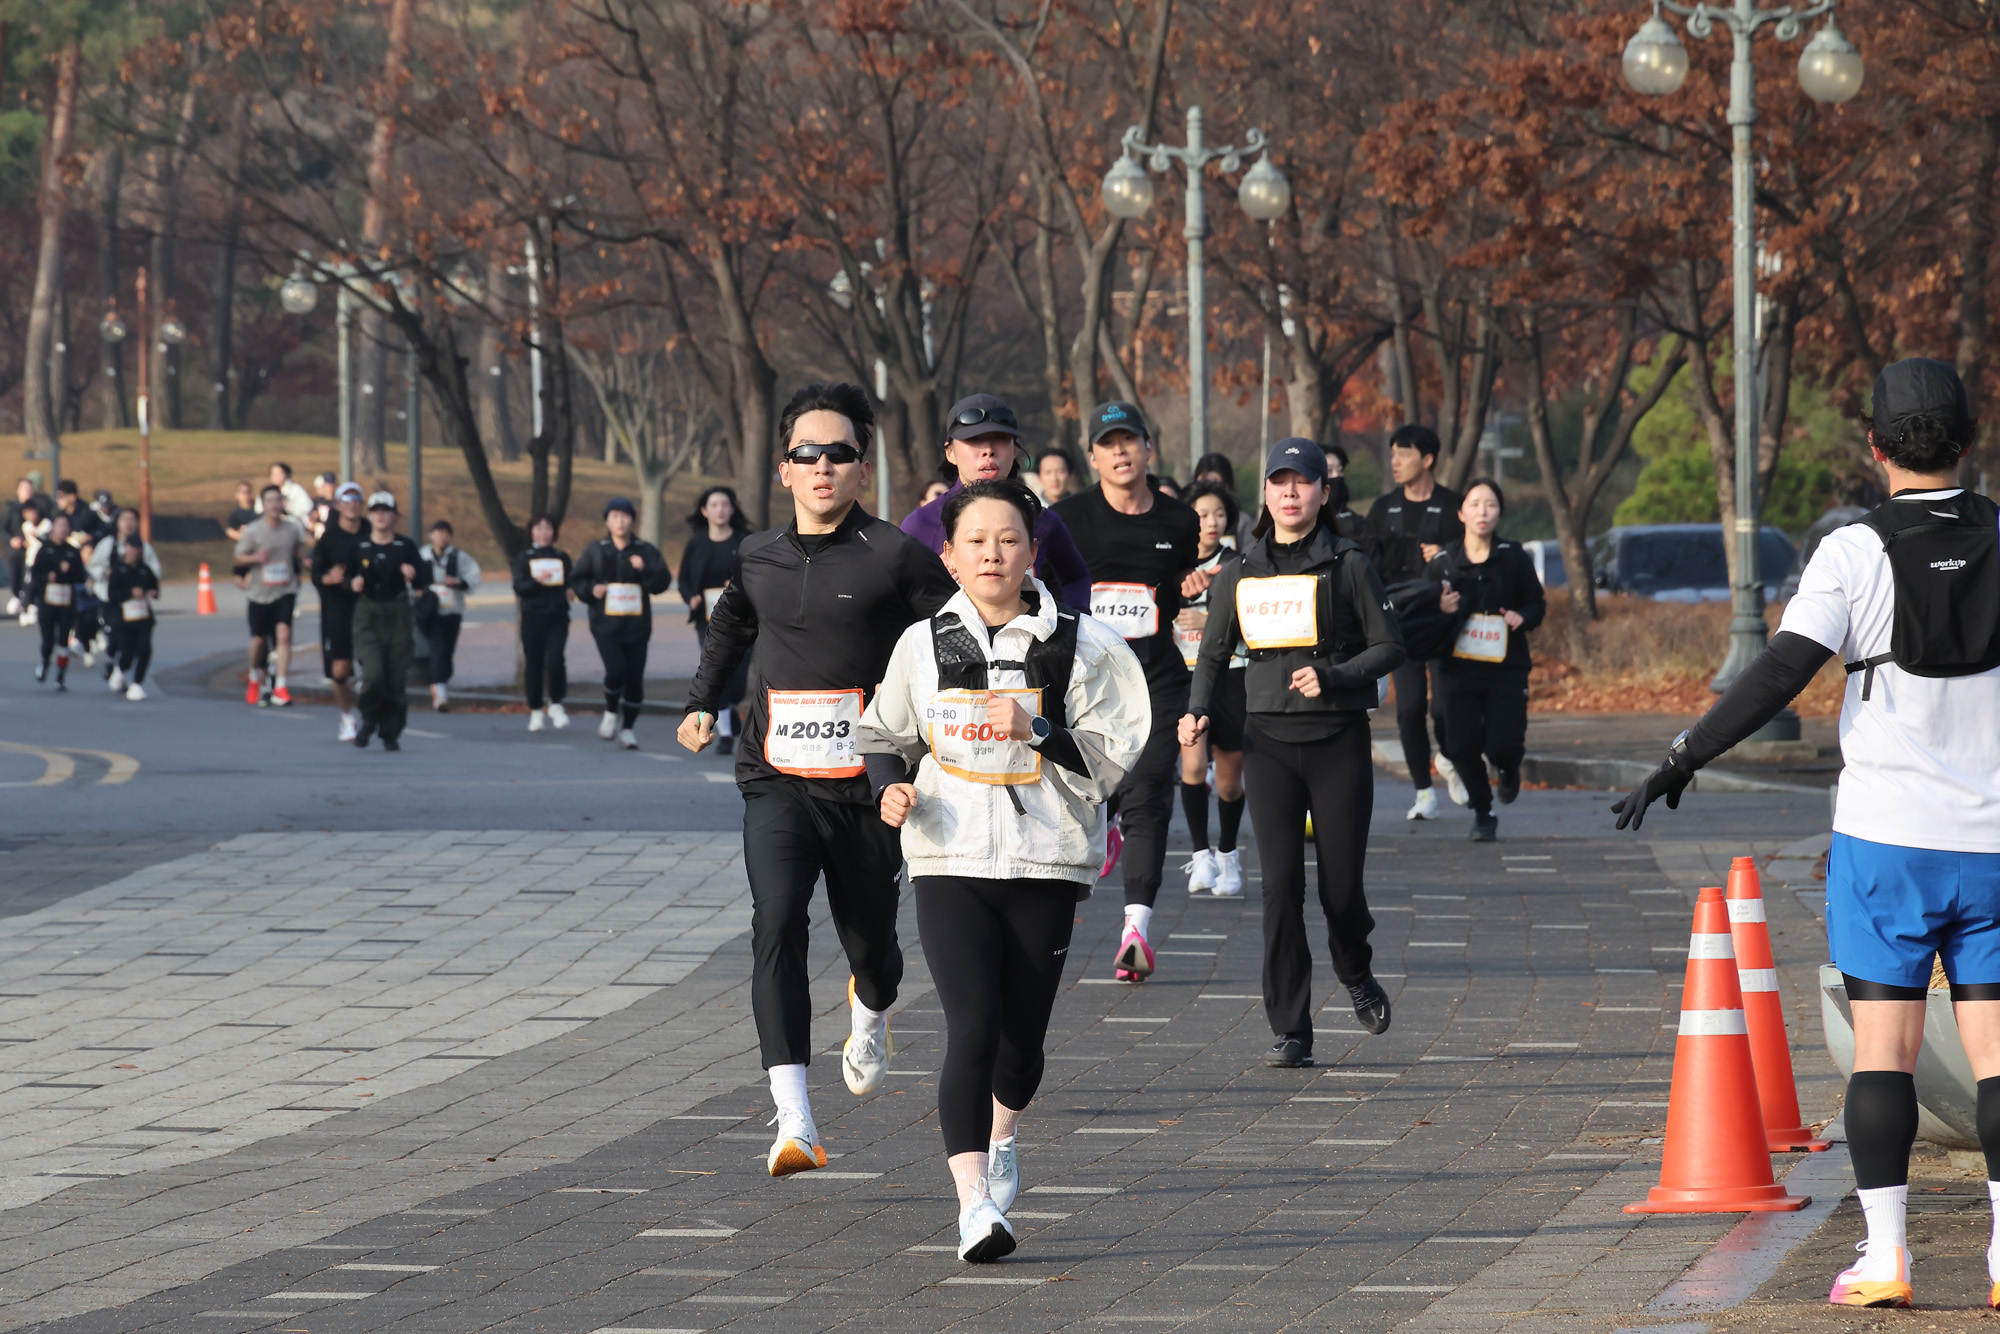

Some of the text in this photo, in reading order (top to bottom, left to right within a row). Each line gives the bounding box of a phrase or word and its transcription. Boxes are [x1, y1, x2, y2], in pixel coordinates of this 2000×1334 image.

[1930, 559, 1966, 568] workup
[1095, 604, 1149, 618] M 1347
[1246, 600, 1303, 615] W 6171
[926, 709, 957, 720] D-80
[776, 720, 850, 739] M 2033
[944, 724, 960, 736] W
